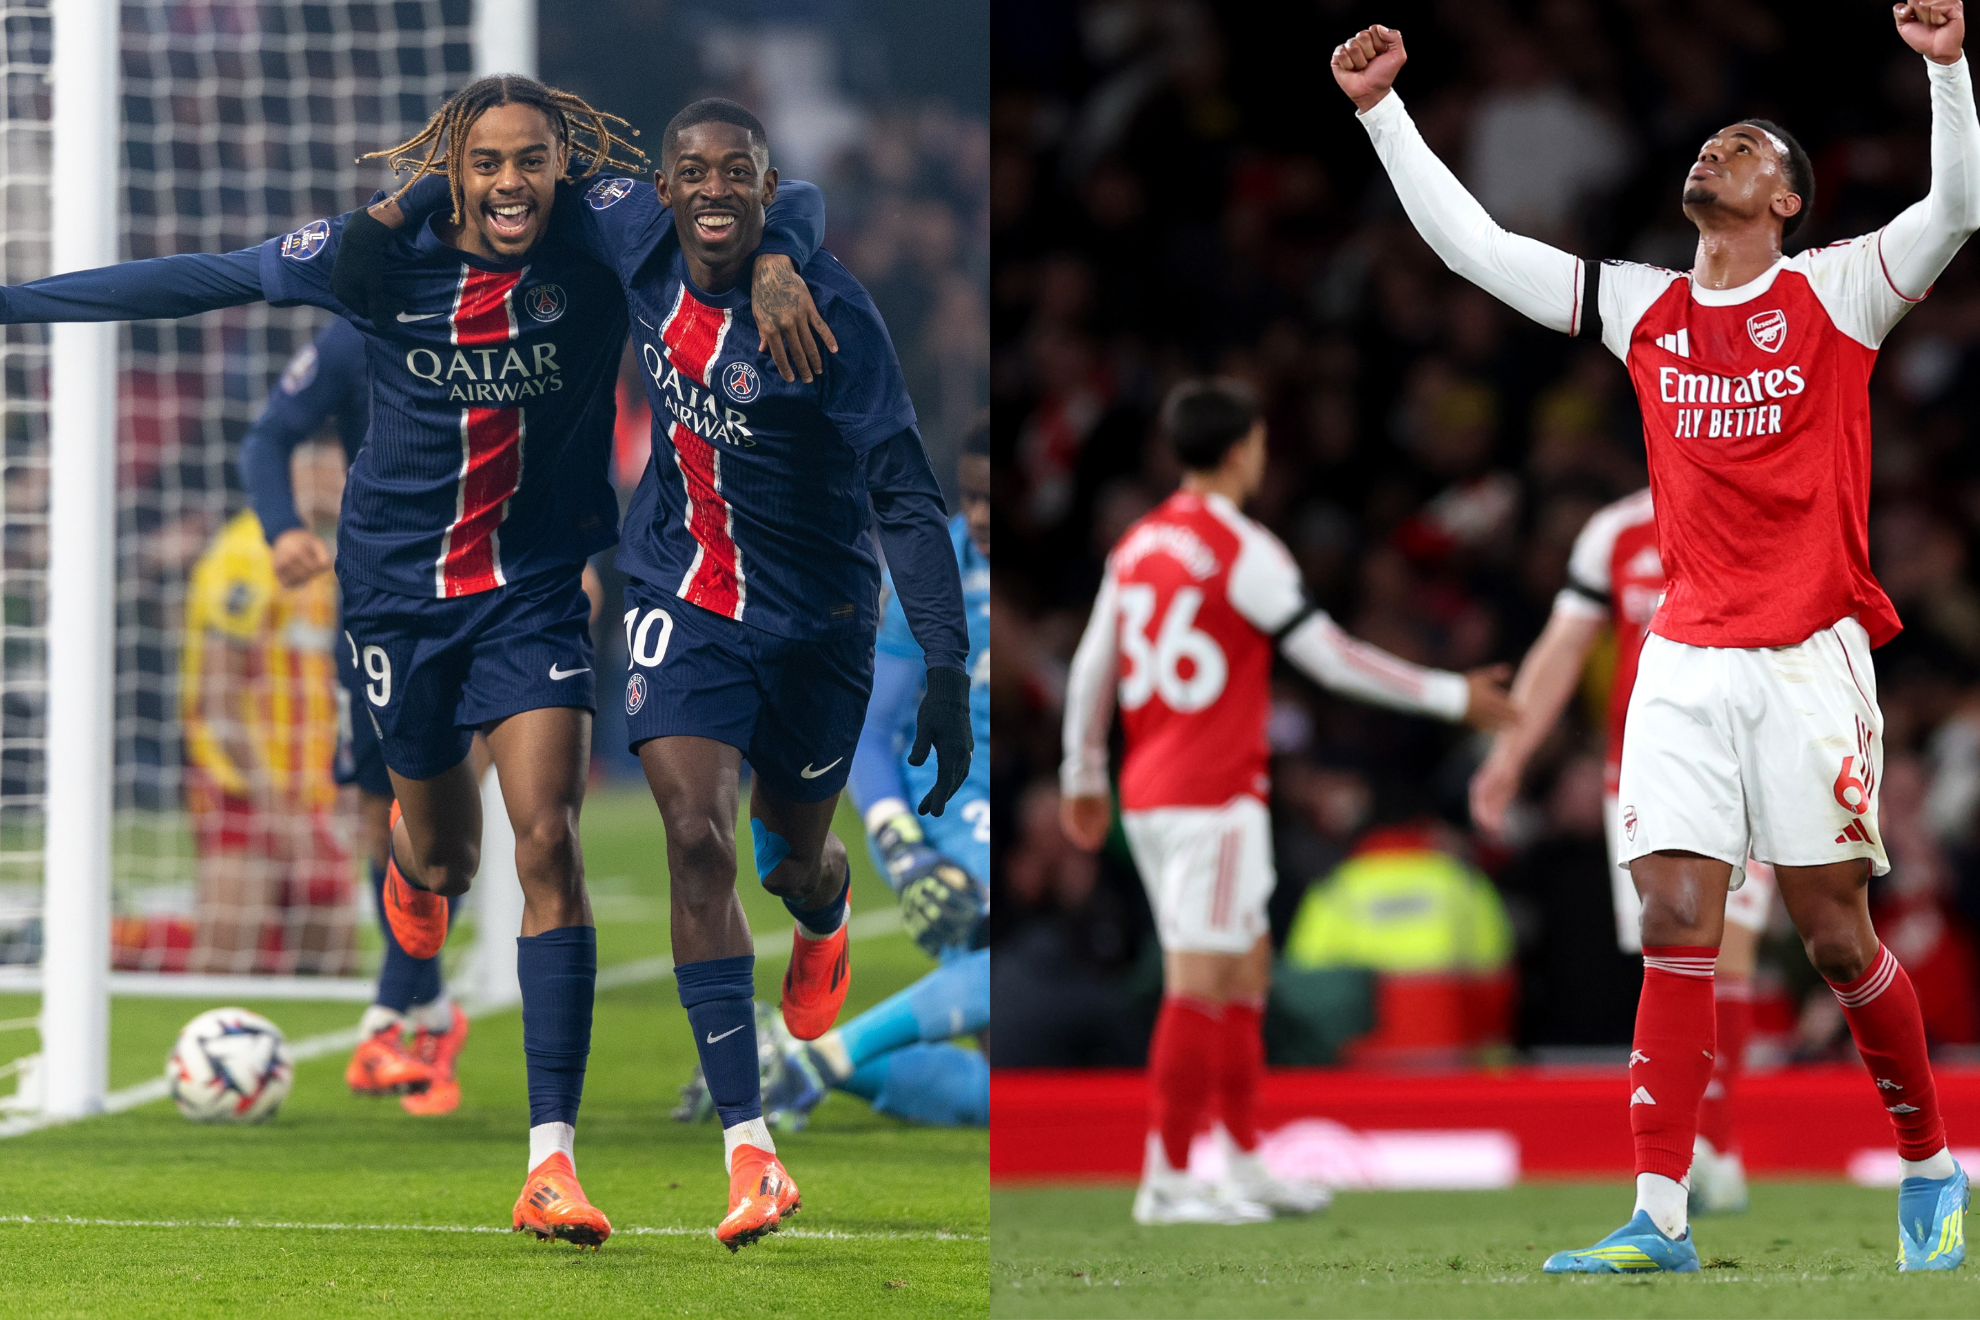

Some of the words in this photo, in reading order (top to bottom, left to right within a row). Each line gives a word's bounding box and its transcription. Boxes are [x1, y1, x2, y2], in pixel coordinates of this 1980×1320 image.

[530, 285, 557, 296] PARIS
[1753, 314, 1781, 331] Arsenal
[406, 342, 561, 387] QATAR
[732, 364, 756, 379] PARIS
[1658, 364, 1806, 404] Emirates
[449, 372, 563, 402] AIRWAYS
[643, 343, 754, 434] QATAR
[665, 395, 757, 448] AIRWAYS
[1674, 408, 1704, 438] FLY
[1708, 404, 1782, 438] BETTER
[623, 607, 674, 671] 10
[1117, 583, 1229, 715] 36
[1833, 755, 1870, 815] 6
